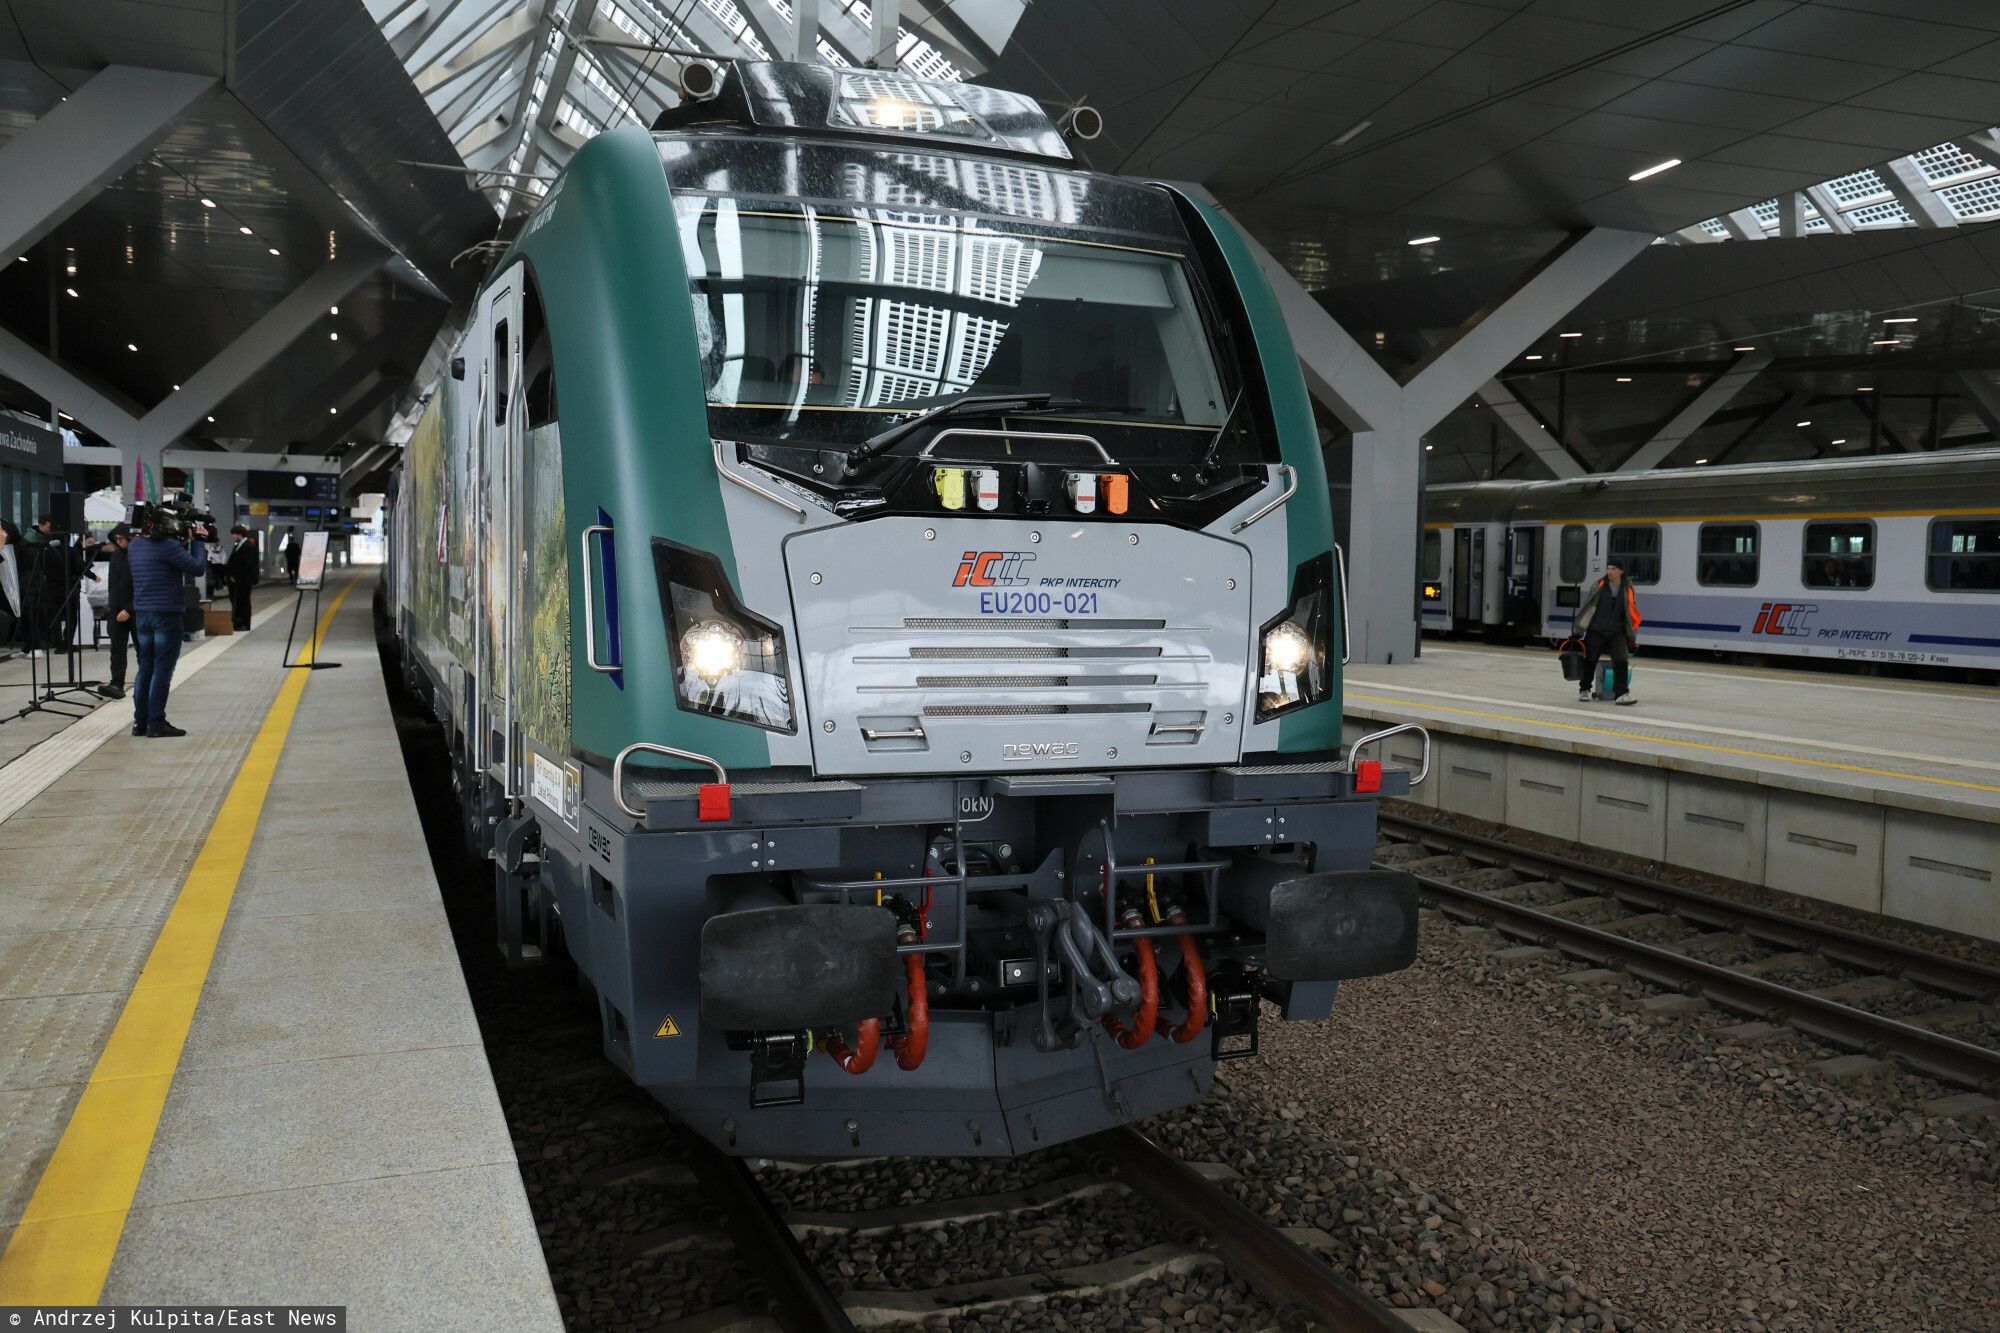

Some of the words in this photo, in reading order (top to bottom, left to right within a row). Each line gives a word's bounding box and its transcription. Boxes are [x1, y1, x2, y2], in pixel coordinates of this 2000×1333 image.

[1593, 530, 1600, 556] 1
[1039, 578, 1064, 587] PKP
[1066, 578, 1121, 588] INTERCITY
[980, 592, 1098, 614] EU200-021
[1817, 629, 1839, 639] PKP
[1840, 630, 1893, 642] INTERCITY
